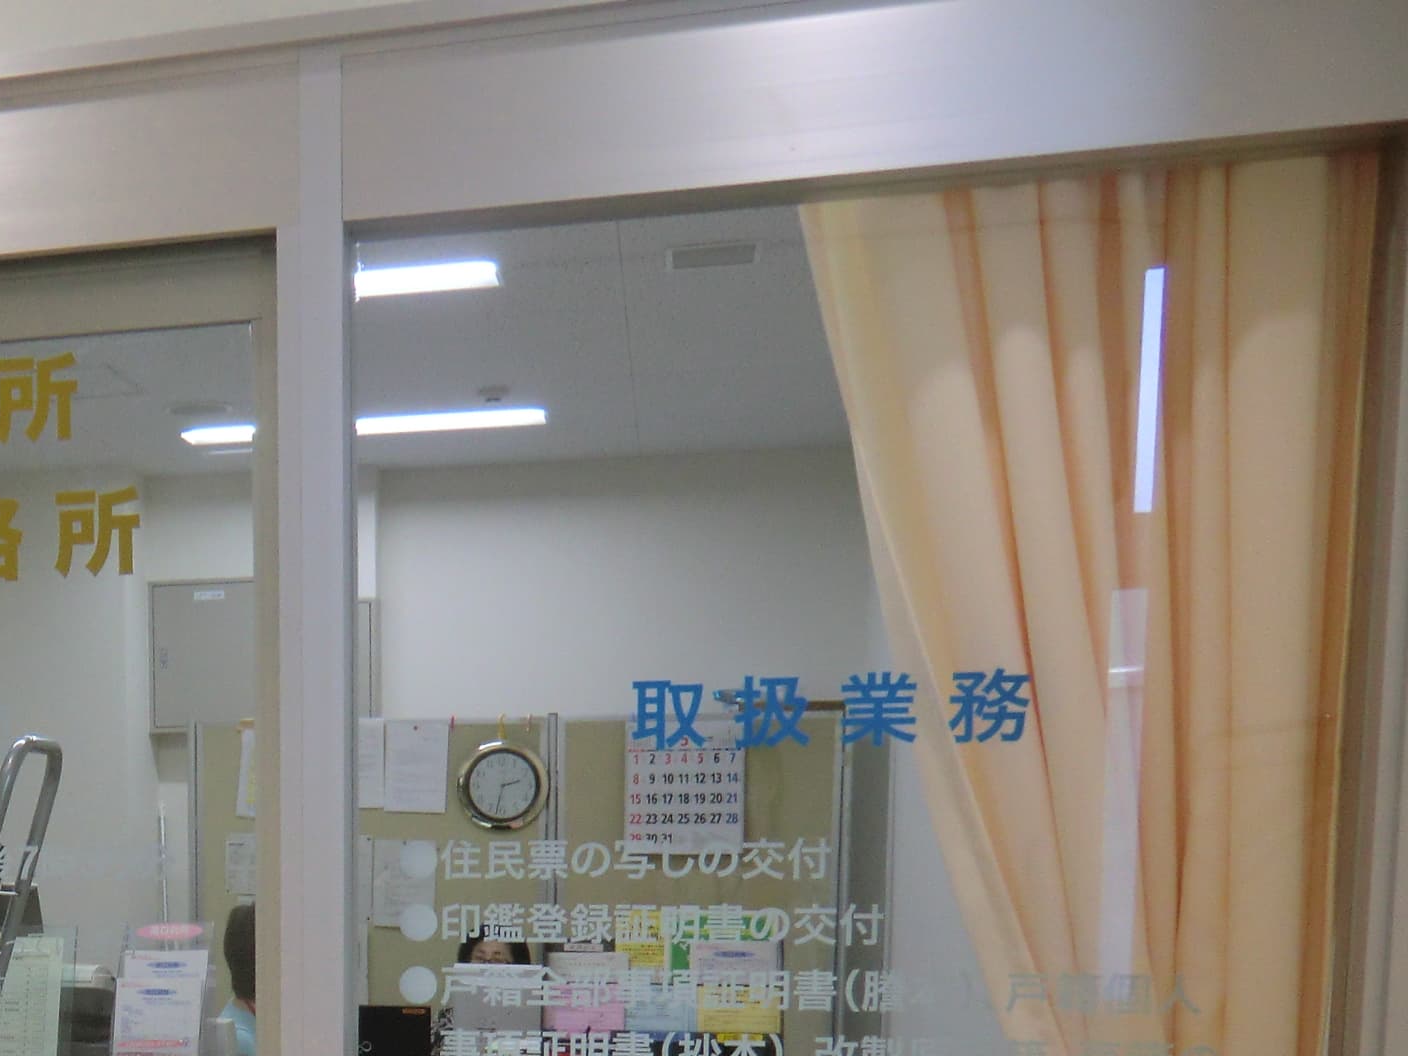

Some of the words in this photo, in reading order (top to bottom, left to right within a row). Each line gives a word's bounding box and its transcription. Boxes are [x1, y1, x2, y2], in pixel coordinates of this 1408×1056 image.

[630, 666, 1032, 751] 取扱業務
[633, 752, 639, 765] 1
[649, 752, 656, 765] 2
[665, 752, 672, 765] 3
[681, 752, 688, 765] 4
[697, 752, 704, 765] 5
[713, 752, 720, 765] 6
[729, 752, 736, 765] 7
[632, 772, 640, 785] 8
[649, 772, 656, 785] 9
[662, 772, 674, 785] 10
[678, 772, 690, 785] 11
[695, 772, 706, 785] 12
[711, 772, 722, 785] 13
[727, 772, 739, 785] 14
[630, 792, 641, 805] 15
[645, 792, 658, 805] 16
[662, 792, 674, 805] 17
[678, 792, 690, 805] 18
[694, 792, 706, 805] 19
[710, 792, 723, 805] 20
[726, 792, 738, 805] 21
[629, 812, 642, 825] 22
[645, 812, 658, 825] 23
[661, 812, 674, 825] 24
[677, 812, 690, 825] 25
[694, 812, 707, 825] 26
[710, 812, 722, 825] 27
[726, 812, 739, 825] 28
[441, 838, 832, 881] 住民票の写しの交付
[441, 902, 885, 947] 印鑑登録証明書の交付
